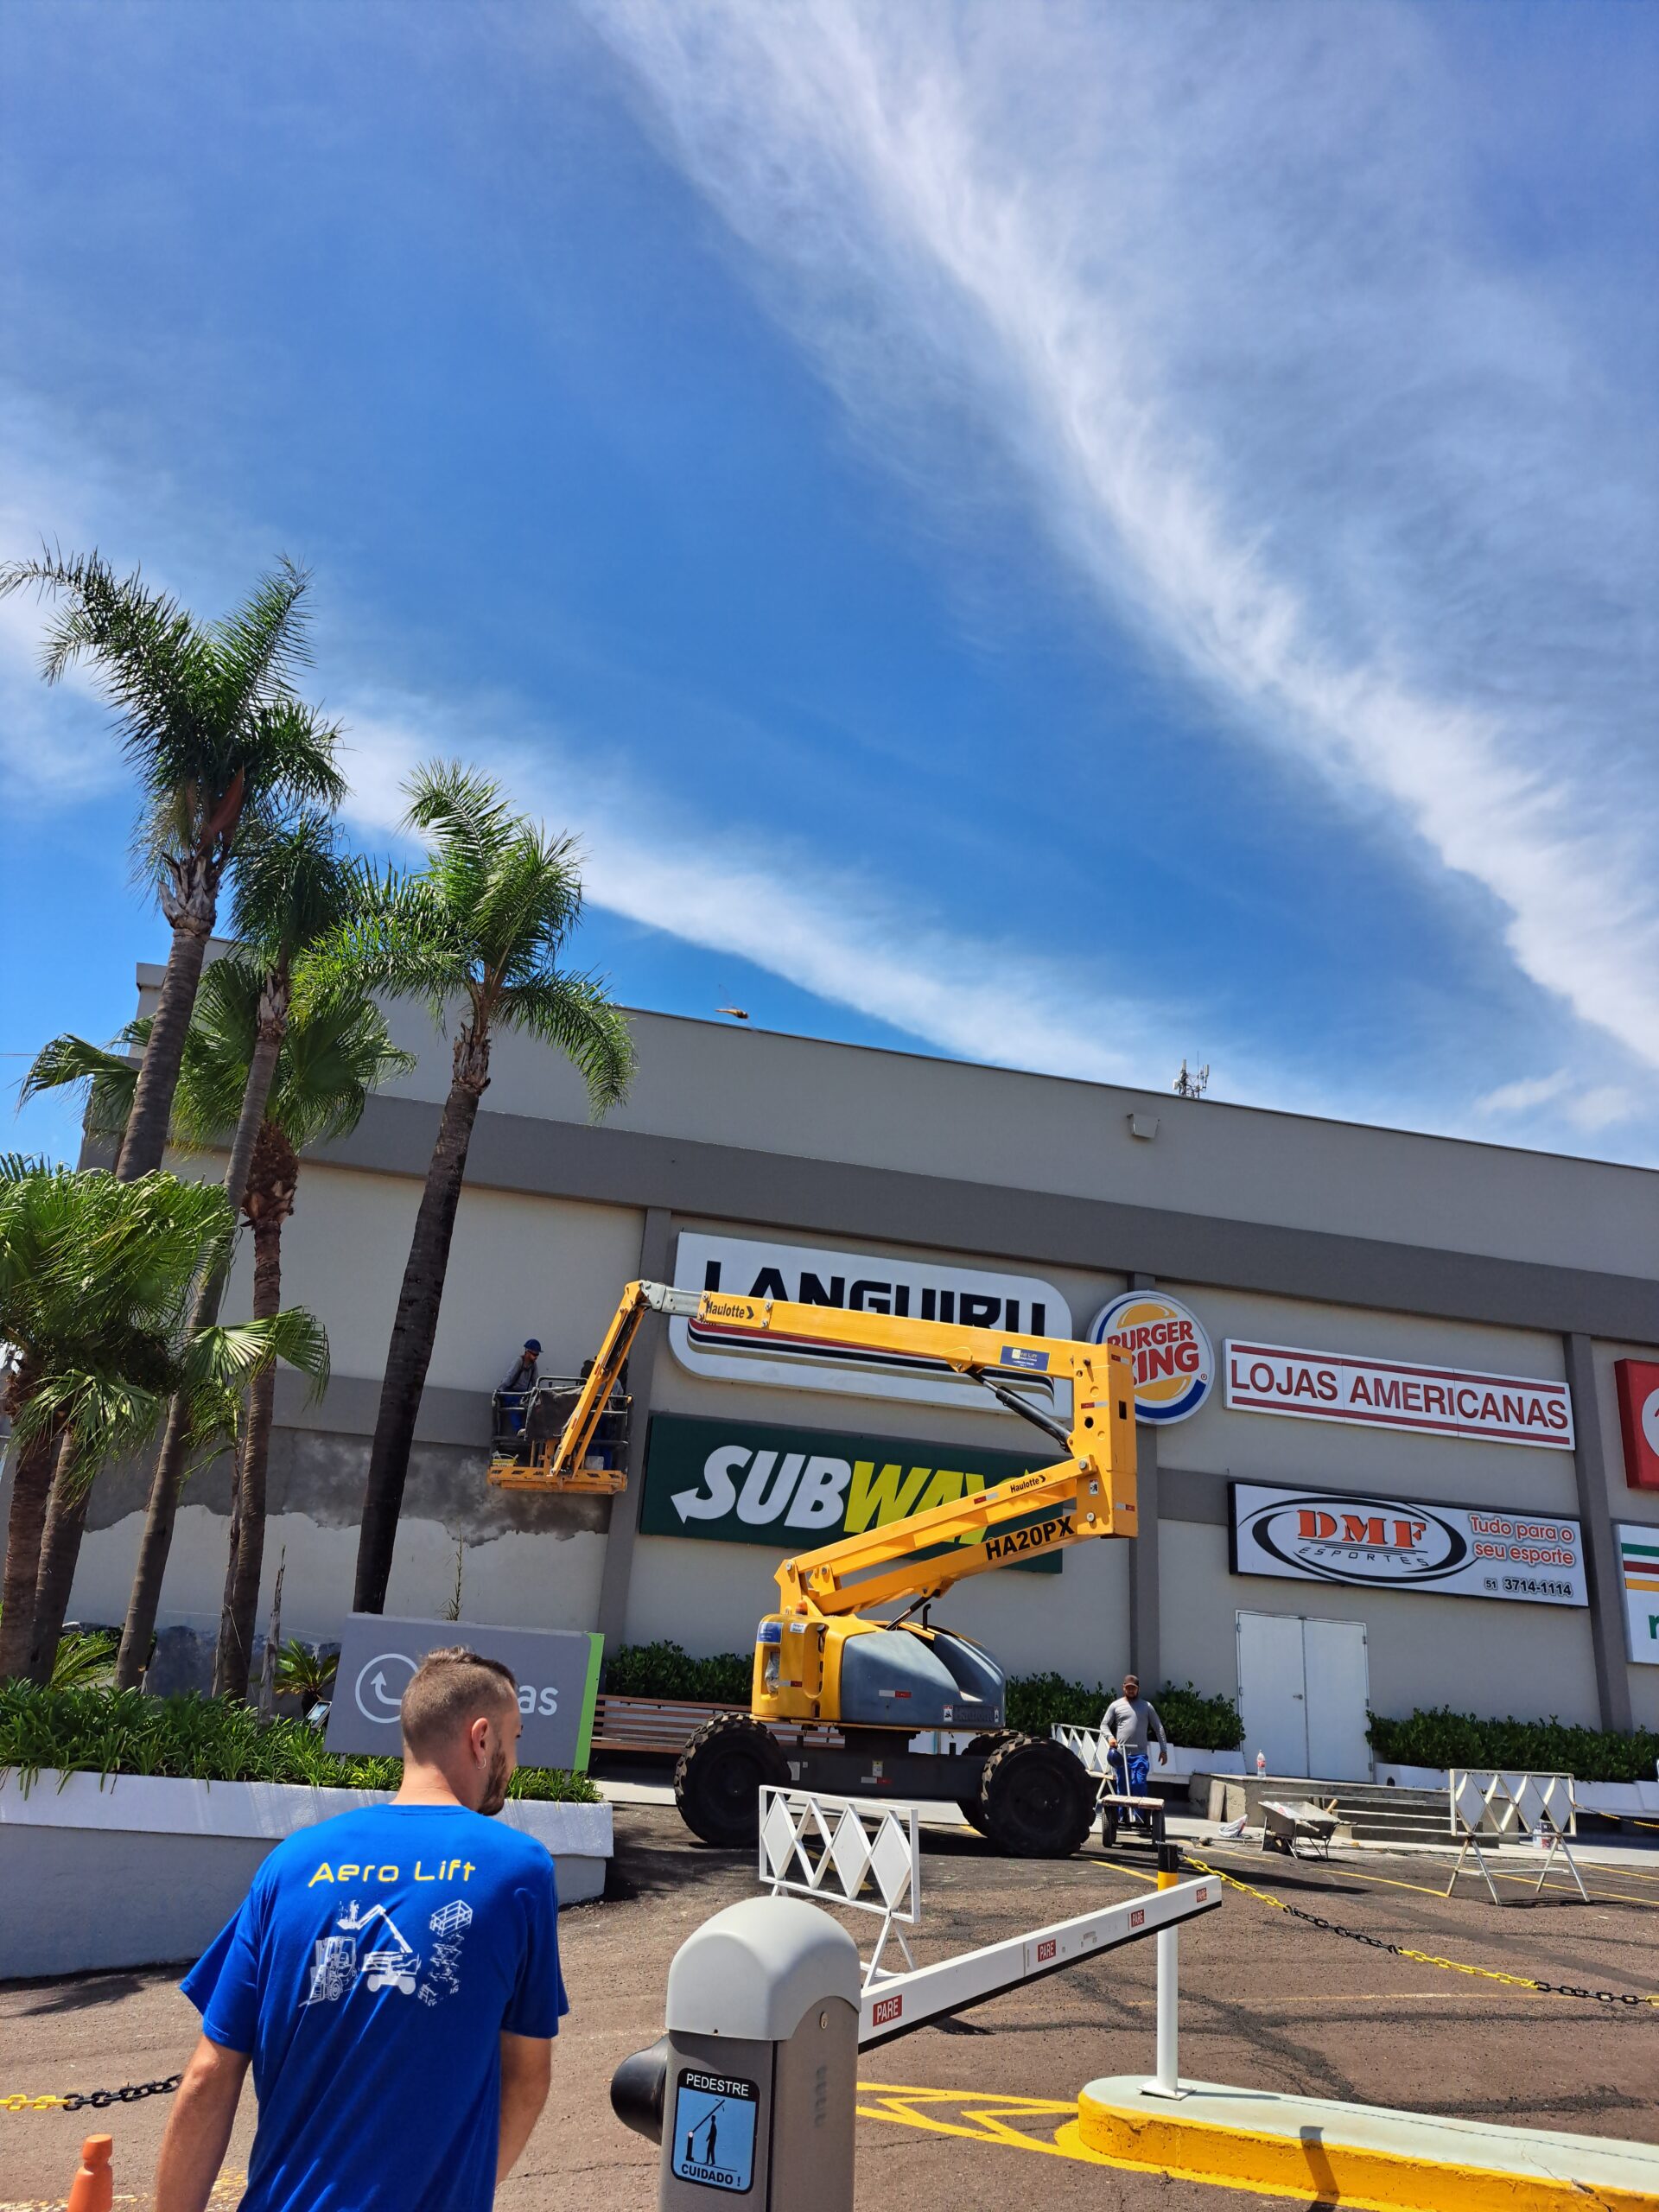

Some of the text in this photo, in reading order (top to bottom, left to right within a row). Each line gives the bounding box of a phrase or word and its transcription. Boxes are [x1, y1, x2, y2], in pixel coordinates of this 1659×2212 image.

[706, 1301, 745, 1319] Haulotte
[1131, 1341, 1199, 1386] ING
[1231, 1359, 1568, 1430] LOJAS AMERICANAS
[1010, 1478, 1039, 1493] Haulotte
[986, 1516, 1074, 1560] HA20PX
[1297, 1509, 1427, 1548] DMF
[1471, 1515, 1573, 1542] Tudo para o
[1299, 1547, 1430, 1567] ESPORTES
[1474, 1543, 1574, 1566] seu esporte
[1485, 1578, 1573, 1596] 51 3714-1114
[308, 1859, 476, 1888] Aero Lift
[1132, 1910, 1144, 1926] PARE
[1039, 1941, 1054, 1961] PARE
[877, 1998, 899, 2023] PARE
[686, 2073, 750, 2097] PEDESTRE
[681, 2164, 734, 2185] CUIDADO
